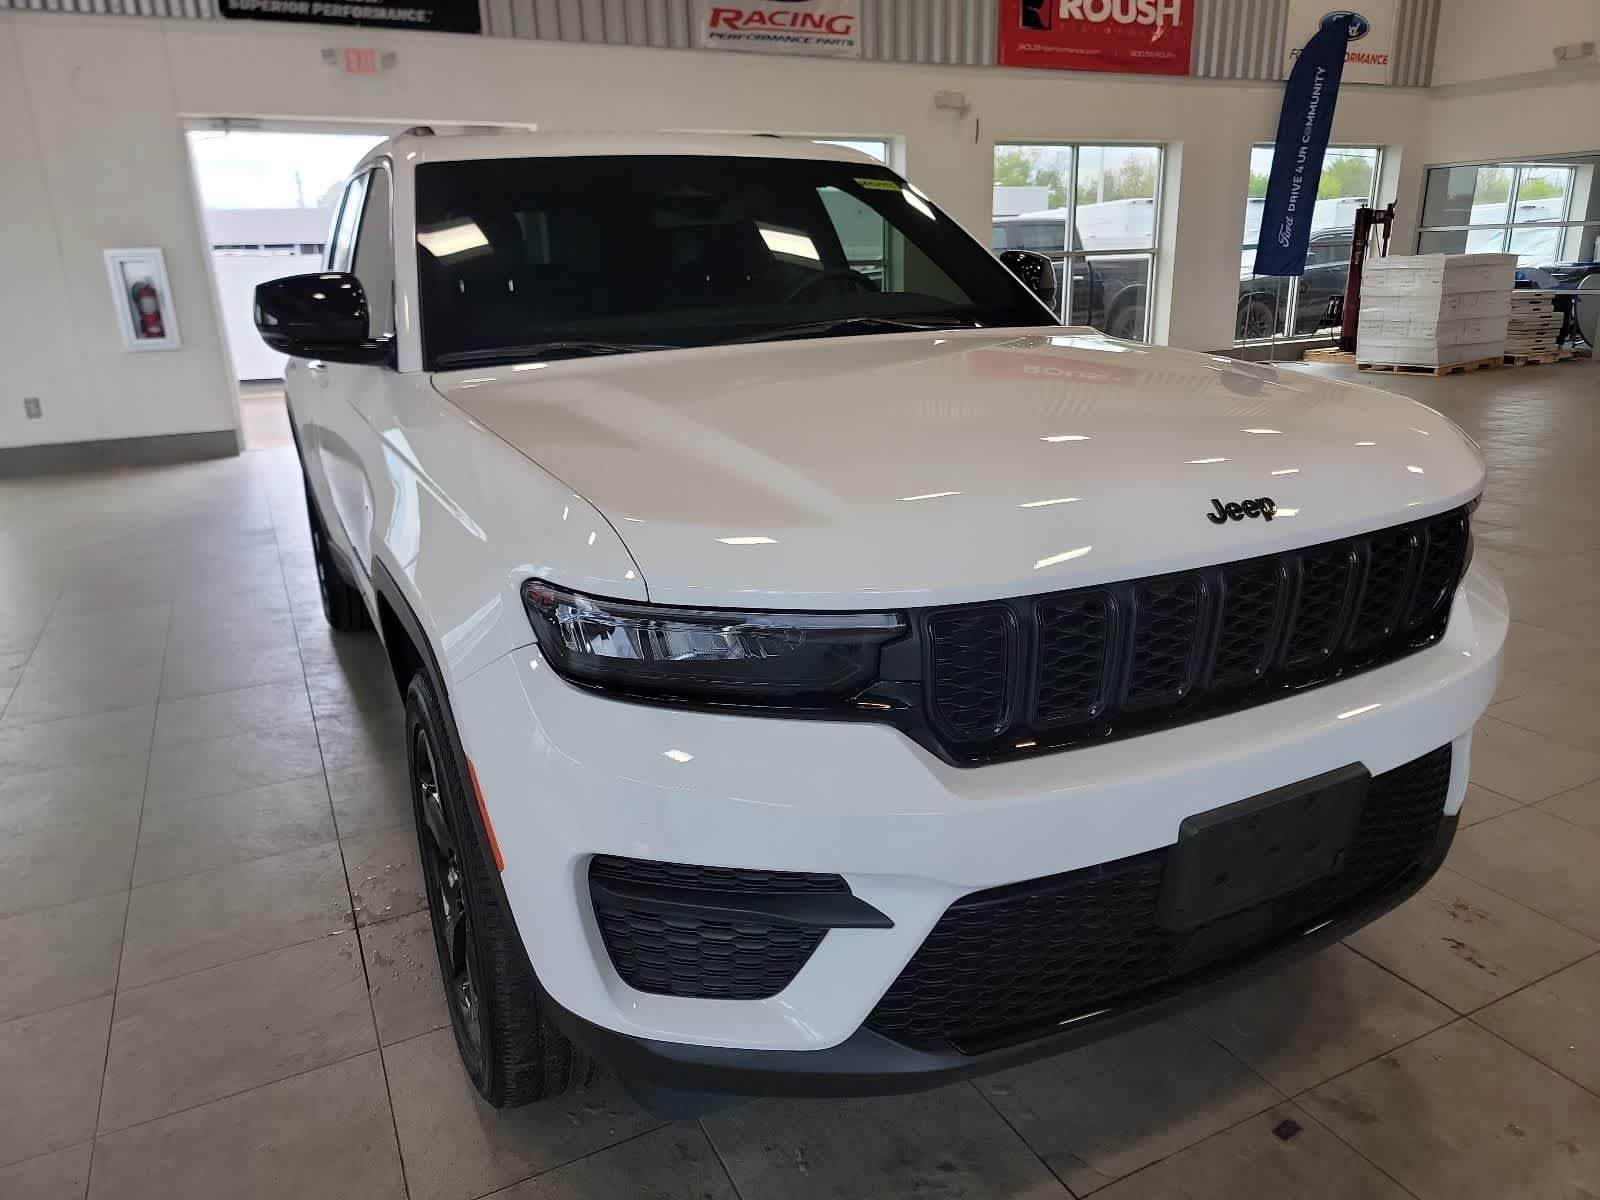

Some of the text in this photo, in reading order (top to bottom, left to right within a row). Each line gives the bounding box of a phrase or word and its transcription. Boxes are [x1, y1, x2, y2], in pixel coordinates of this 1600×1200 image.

[228, 0, 310, 14] SUPERIOR
[1059, 0, 1180, 26] ROUSH
[709, 8, 855, 35] RACING
[708, 31, 811, 45] PERFORMANCE
[1344, 52, 1388, 65] ORMANCE
[1278, 66, 1328, 248] Ford DRIVE 4 UR COMMUNITY
[1206, 497, 1277, 525] Jeep
